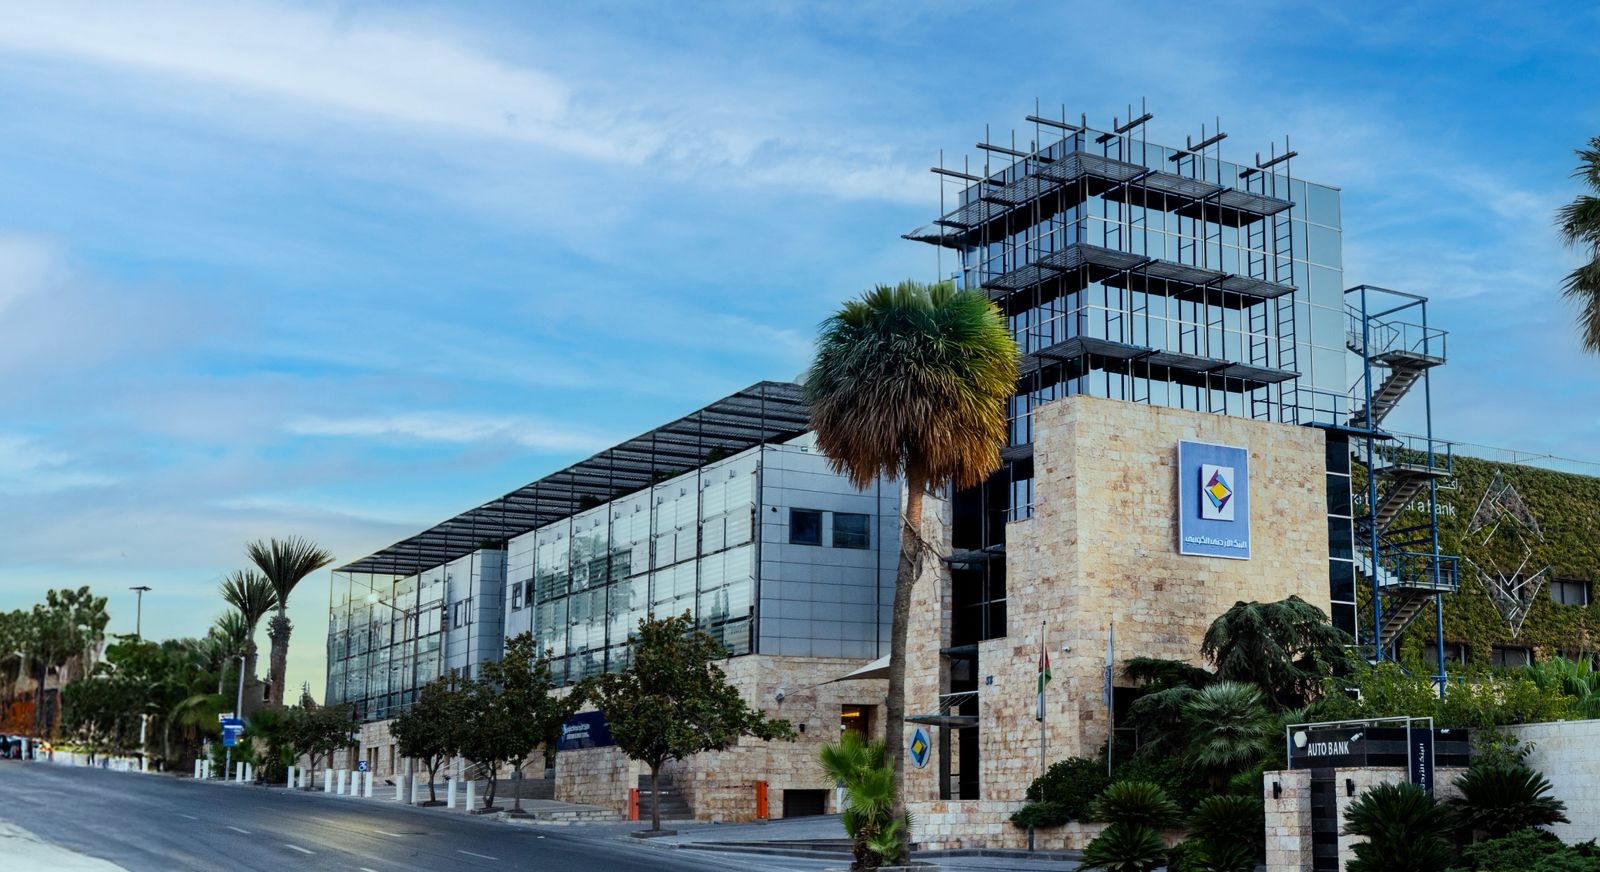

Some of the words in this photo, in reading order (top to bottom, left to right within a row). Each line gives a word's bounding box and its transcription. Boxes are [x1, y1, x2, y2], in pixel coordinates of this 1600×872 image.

[1417, 501, 1425, 513] a
[1307, 742, 1327, 757] AUTO
[1328, 741, 1350, 756] BANK
